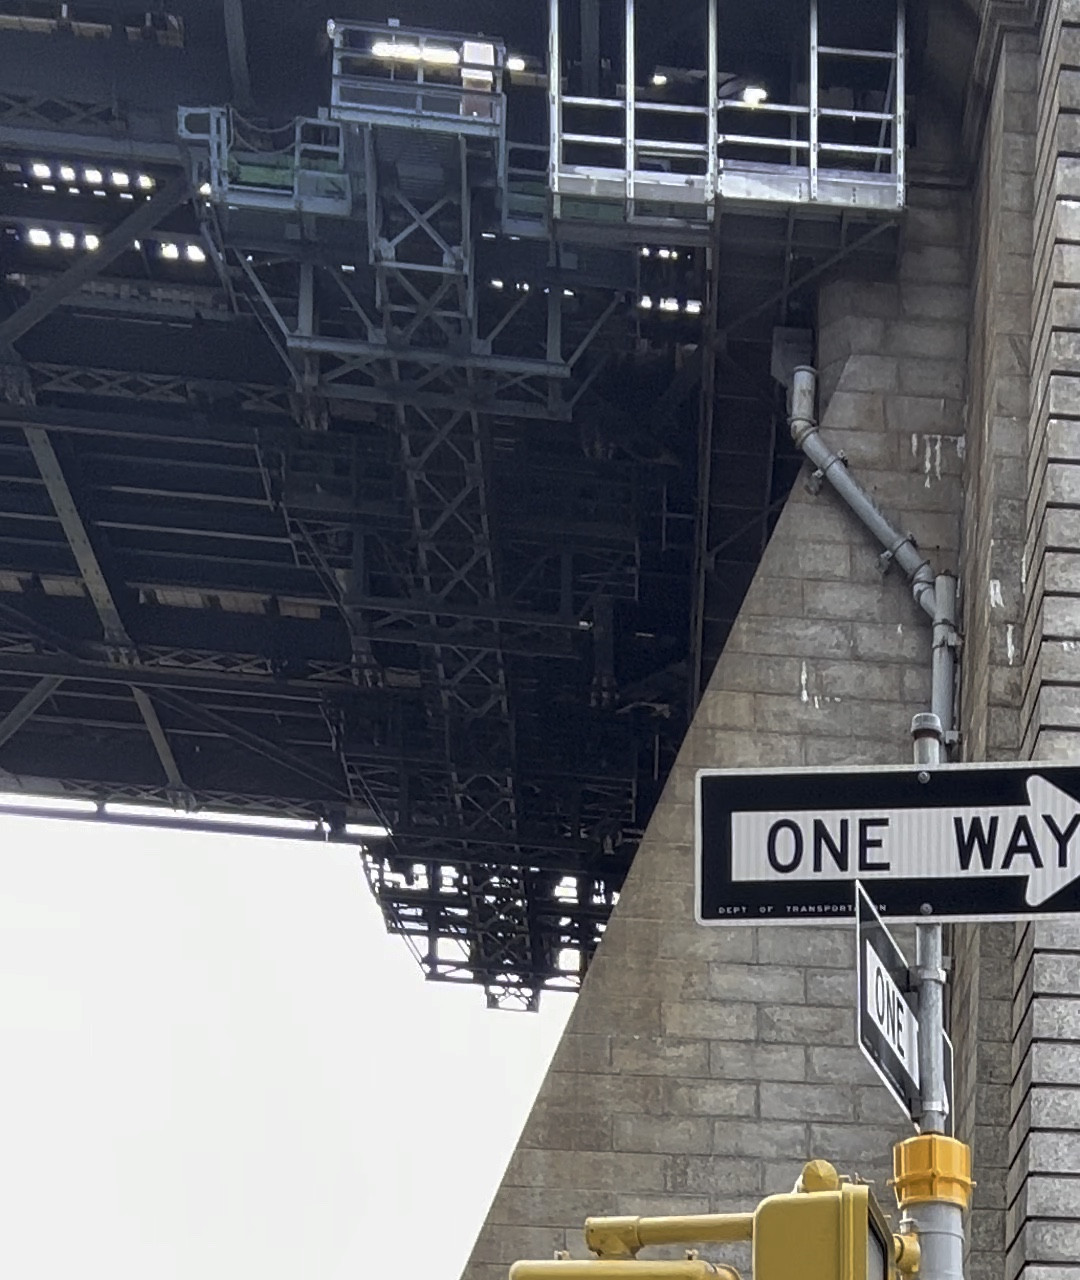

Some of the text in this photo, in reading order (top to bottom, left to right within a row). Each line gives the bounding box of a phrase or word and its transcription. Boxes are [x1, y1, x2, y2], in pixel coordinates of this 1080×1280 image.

[767, 818, 890, 873] ONE
[719, 906, 747, 914] DEPT
[875, 966, 905, 1058] ONE
